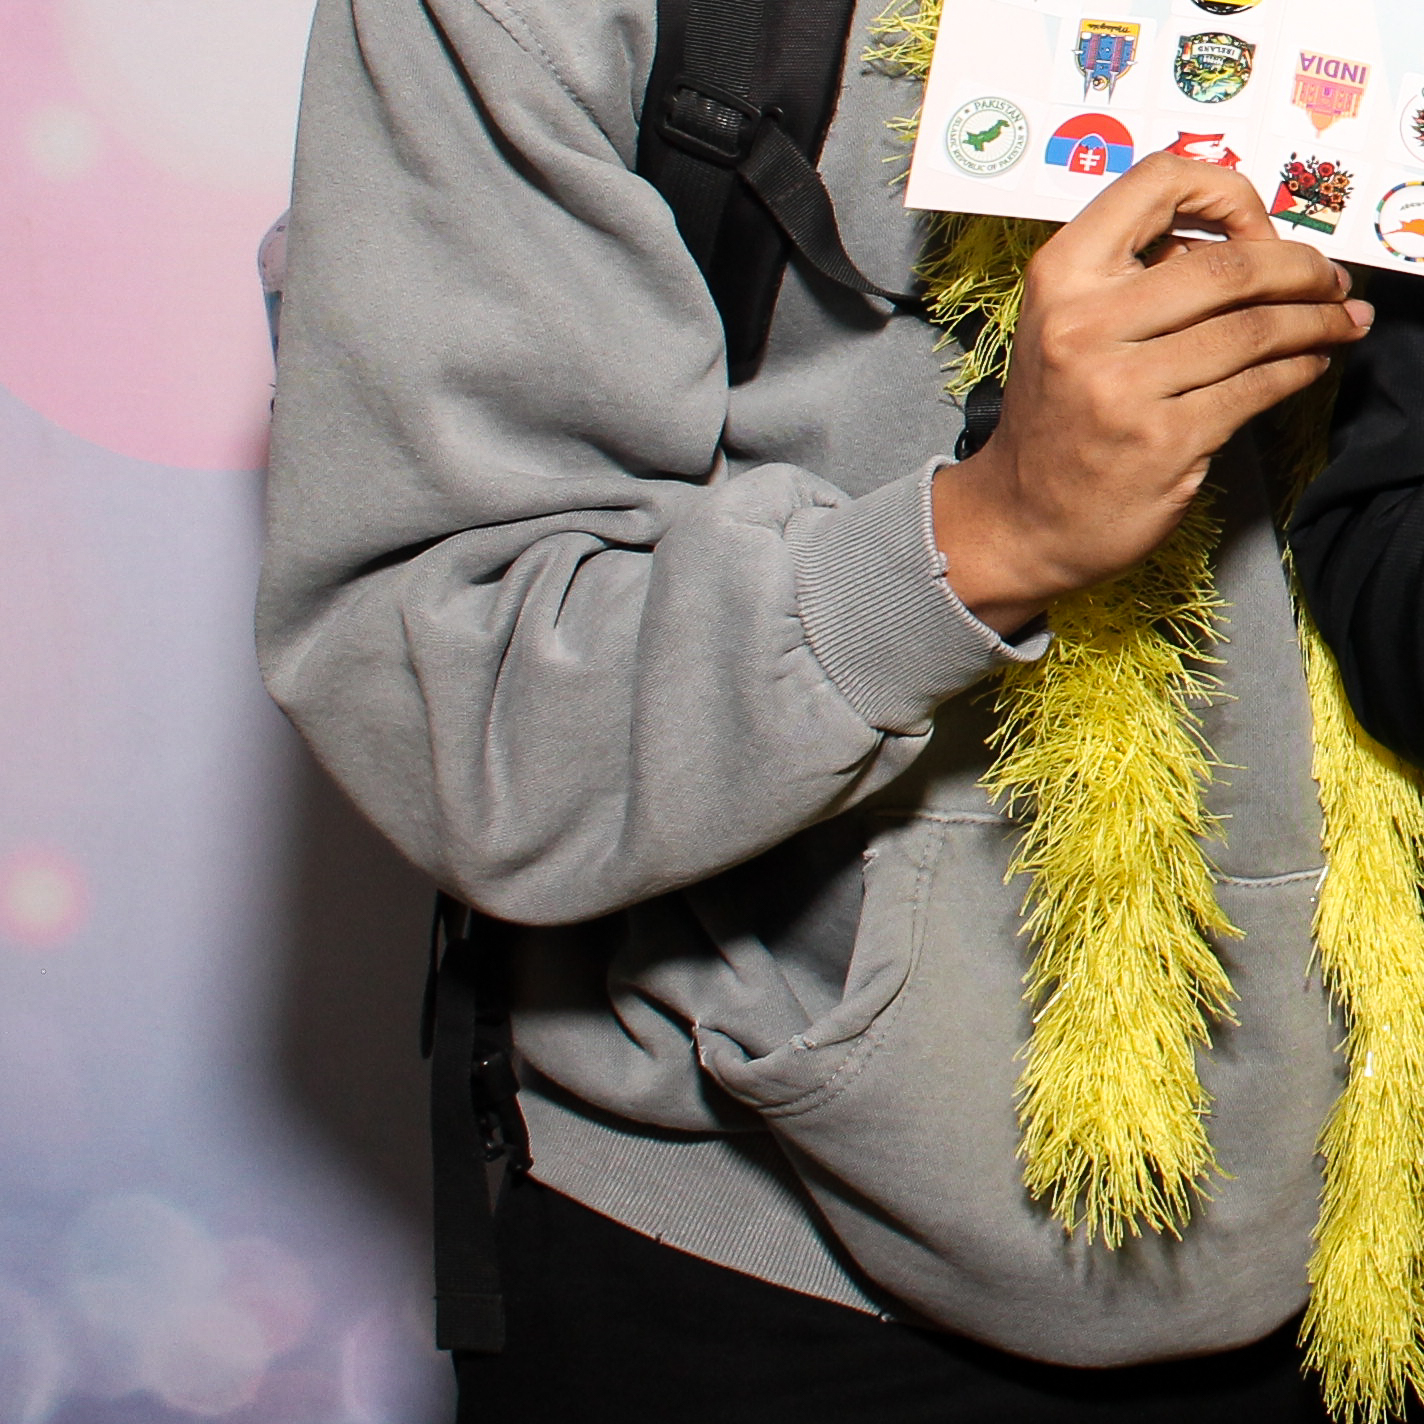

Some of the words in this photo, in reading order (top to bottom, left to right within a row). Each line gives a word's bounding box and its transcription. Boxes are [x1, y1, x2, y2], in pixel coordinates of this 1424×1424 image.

[1198, 45, 1235, 56] IRELAND
[1300, 52, 1366, 84] INDIA
[974, 100, 1024, 122] PAKISTAN
